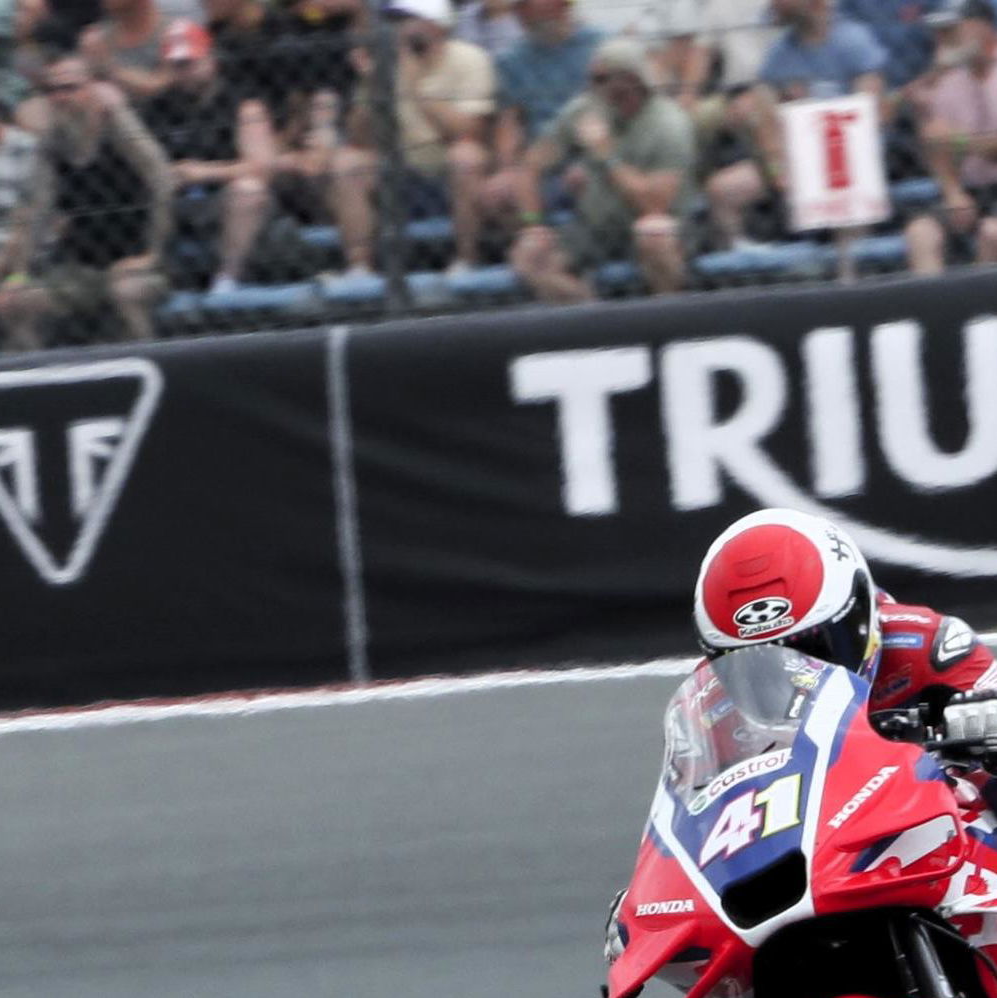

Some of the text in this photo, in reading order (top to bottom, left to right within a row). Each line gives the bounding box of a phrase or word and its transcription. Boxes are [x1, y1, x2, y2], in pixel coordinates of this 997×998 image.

[708, 752, 786, 798] Castrol
[827, 765, 900, 829] HONDA
[699, 773, 802, 868] 41
[635, 899, 695, 917] HONDA
